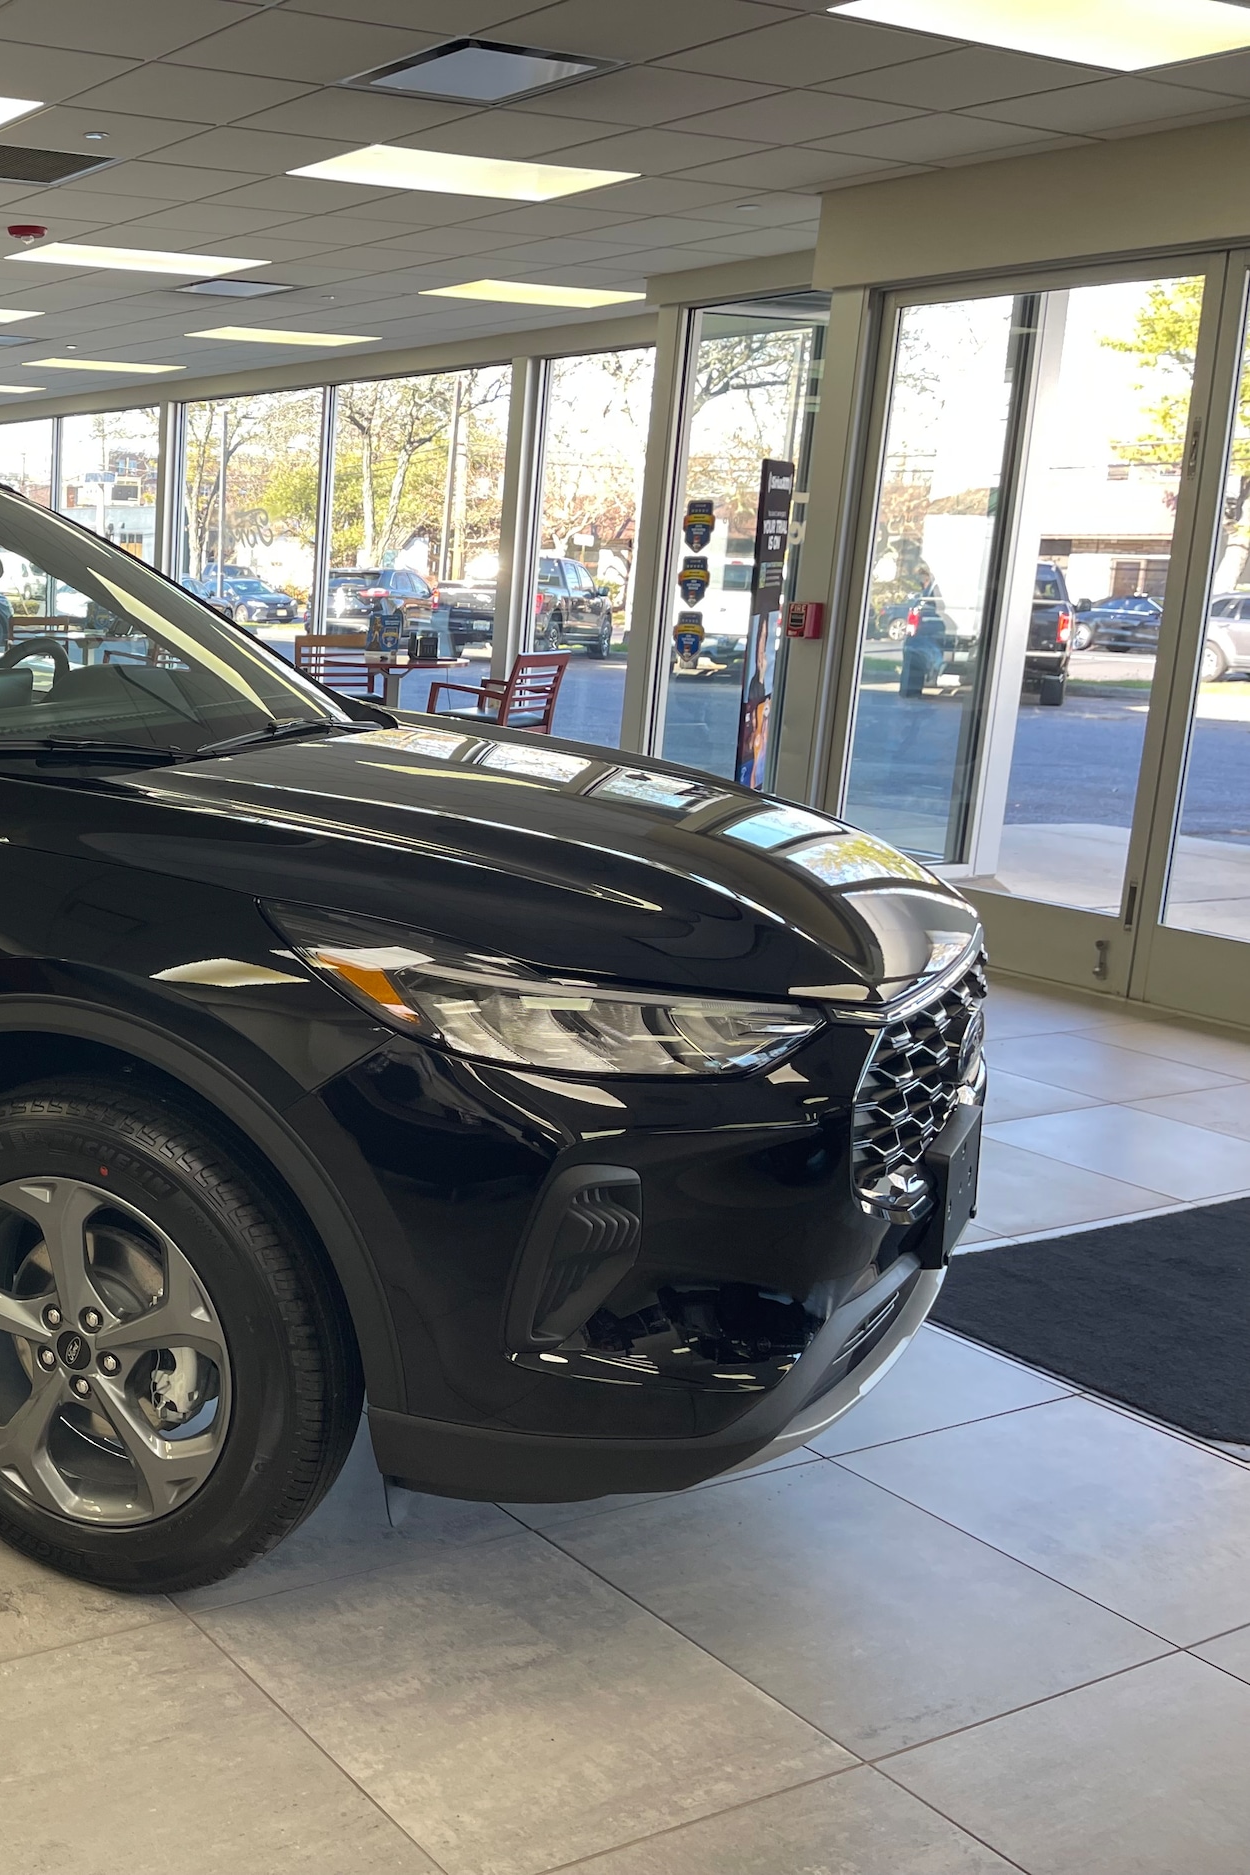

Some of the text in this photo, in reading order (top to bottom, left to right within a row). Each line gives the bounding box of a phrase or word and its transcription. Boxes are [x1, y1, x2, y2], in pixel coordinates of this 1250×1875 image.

[763, 519, 776, 534] YOUR
[776, 520, 788, 535] TRIAL
[773, 535, 781, 550] ON
[790, 604, 807, 612] FIRE
[52, 1131, 172, 1197] MICHELIN
